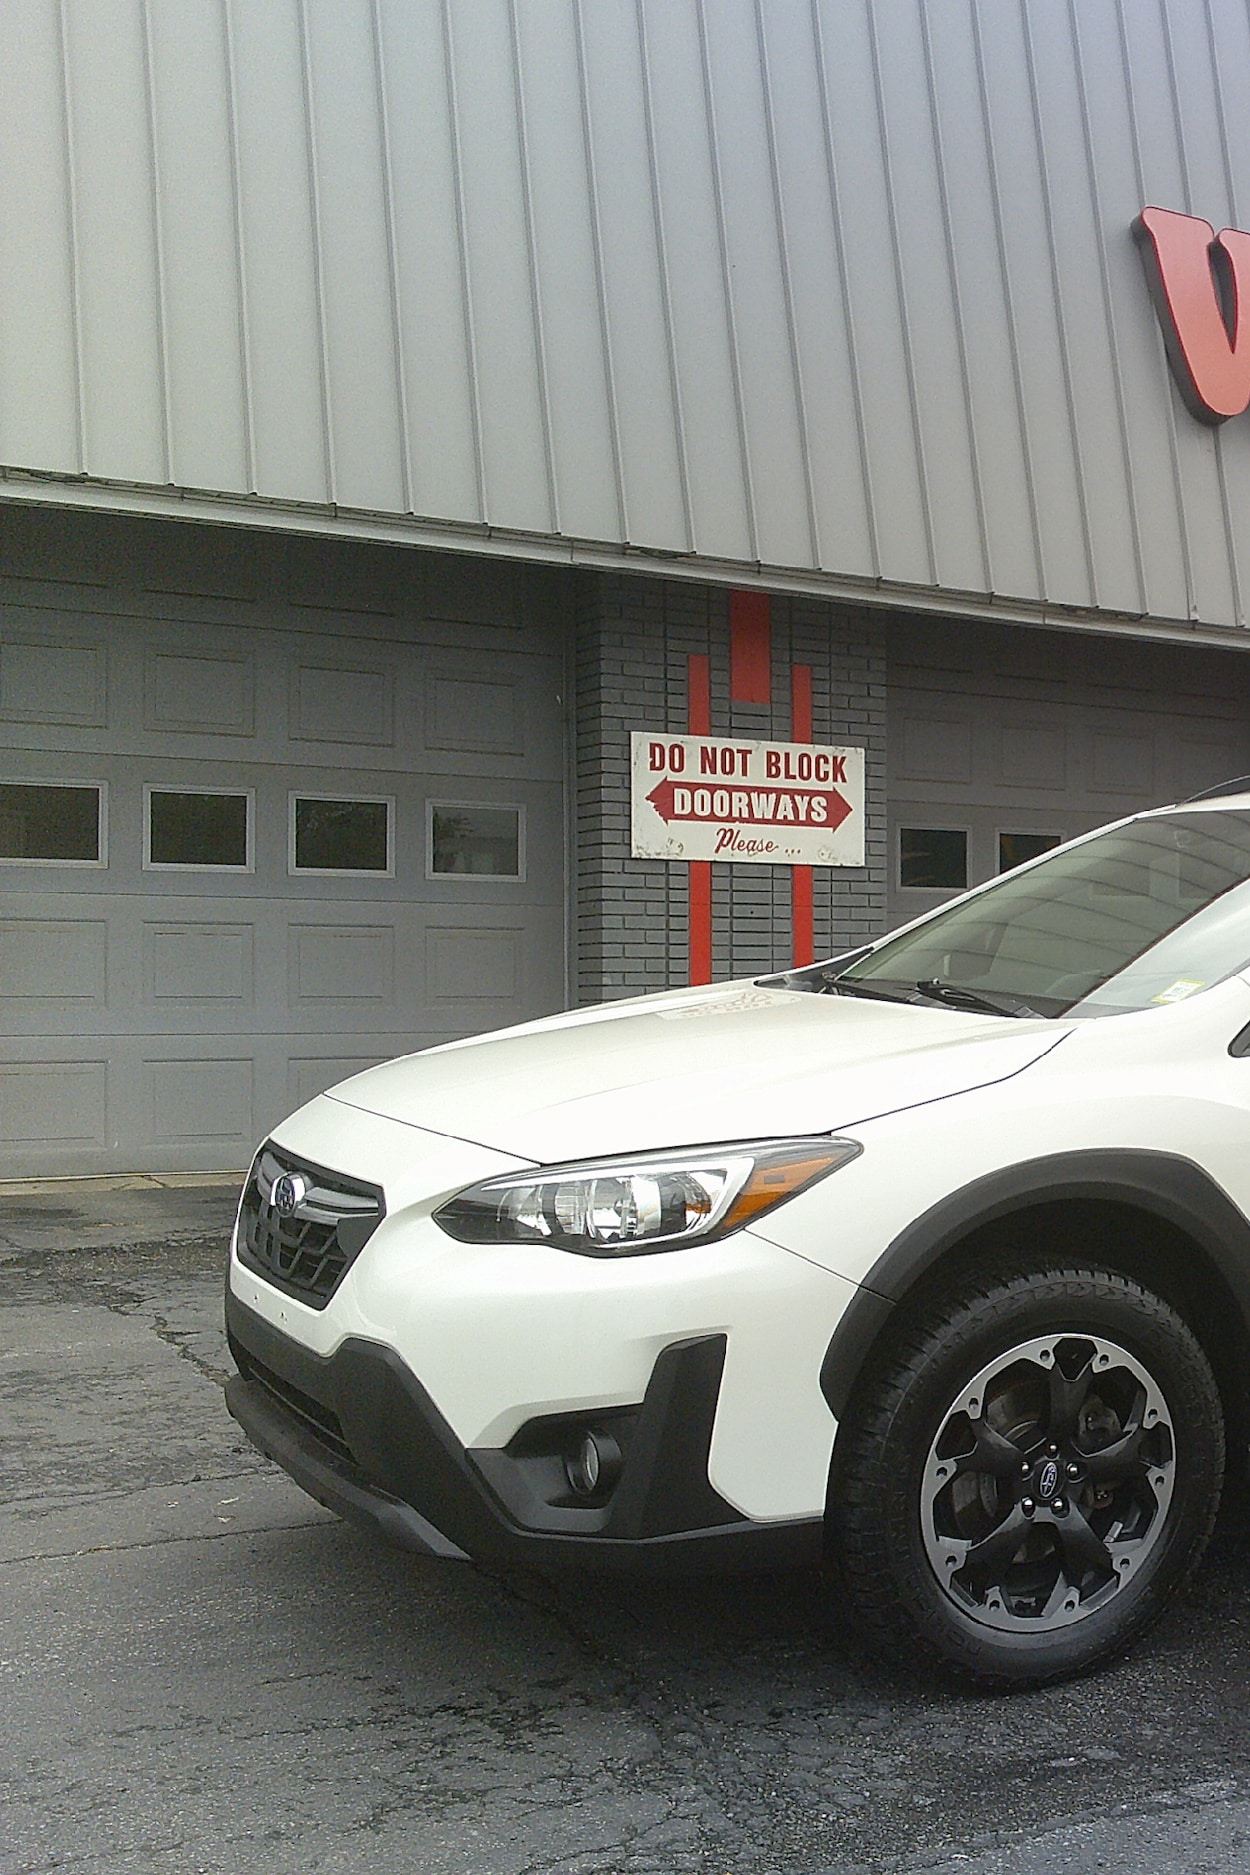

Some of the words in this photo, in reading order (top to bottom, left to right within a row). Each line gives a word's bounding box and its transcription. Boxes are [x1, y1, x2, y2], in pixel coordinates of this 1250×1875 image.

[649, 742, 685, 773] DO
[700, 746, 752, 777] NOT
[766, 751, 847, 783] BLOCK
[673, 788, 828, 823] DOORWAYS
